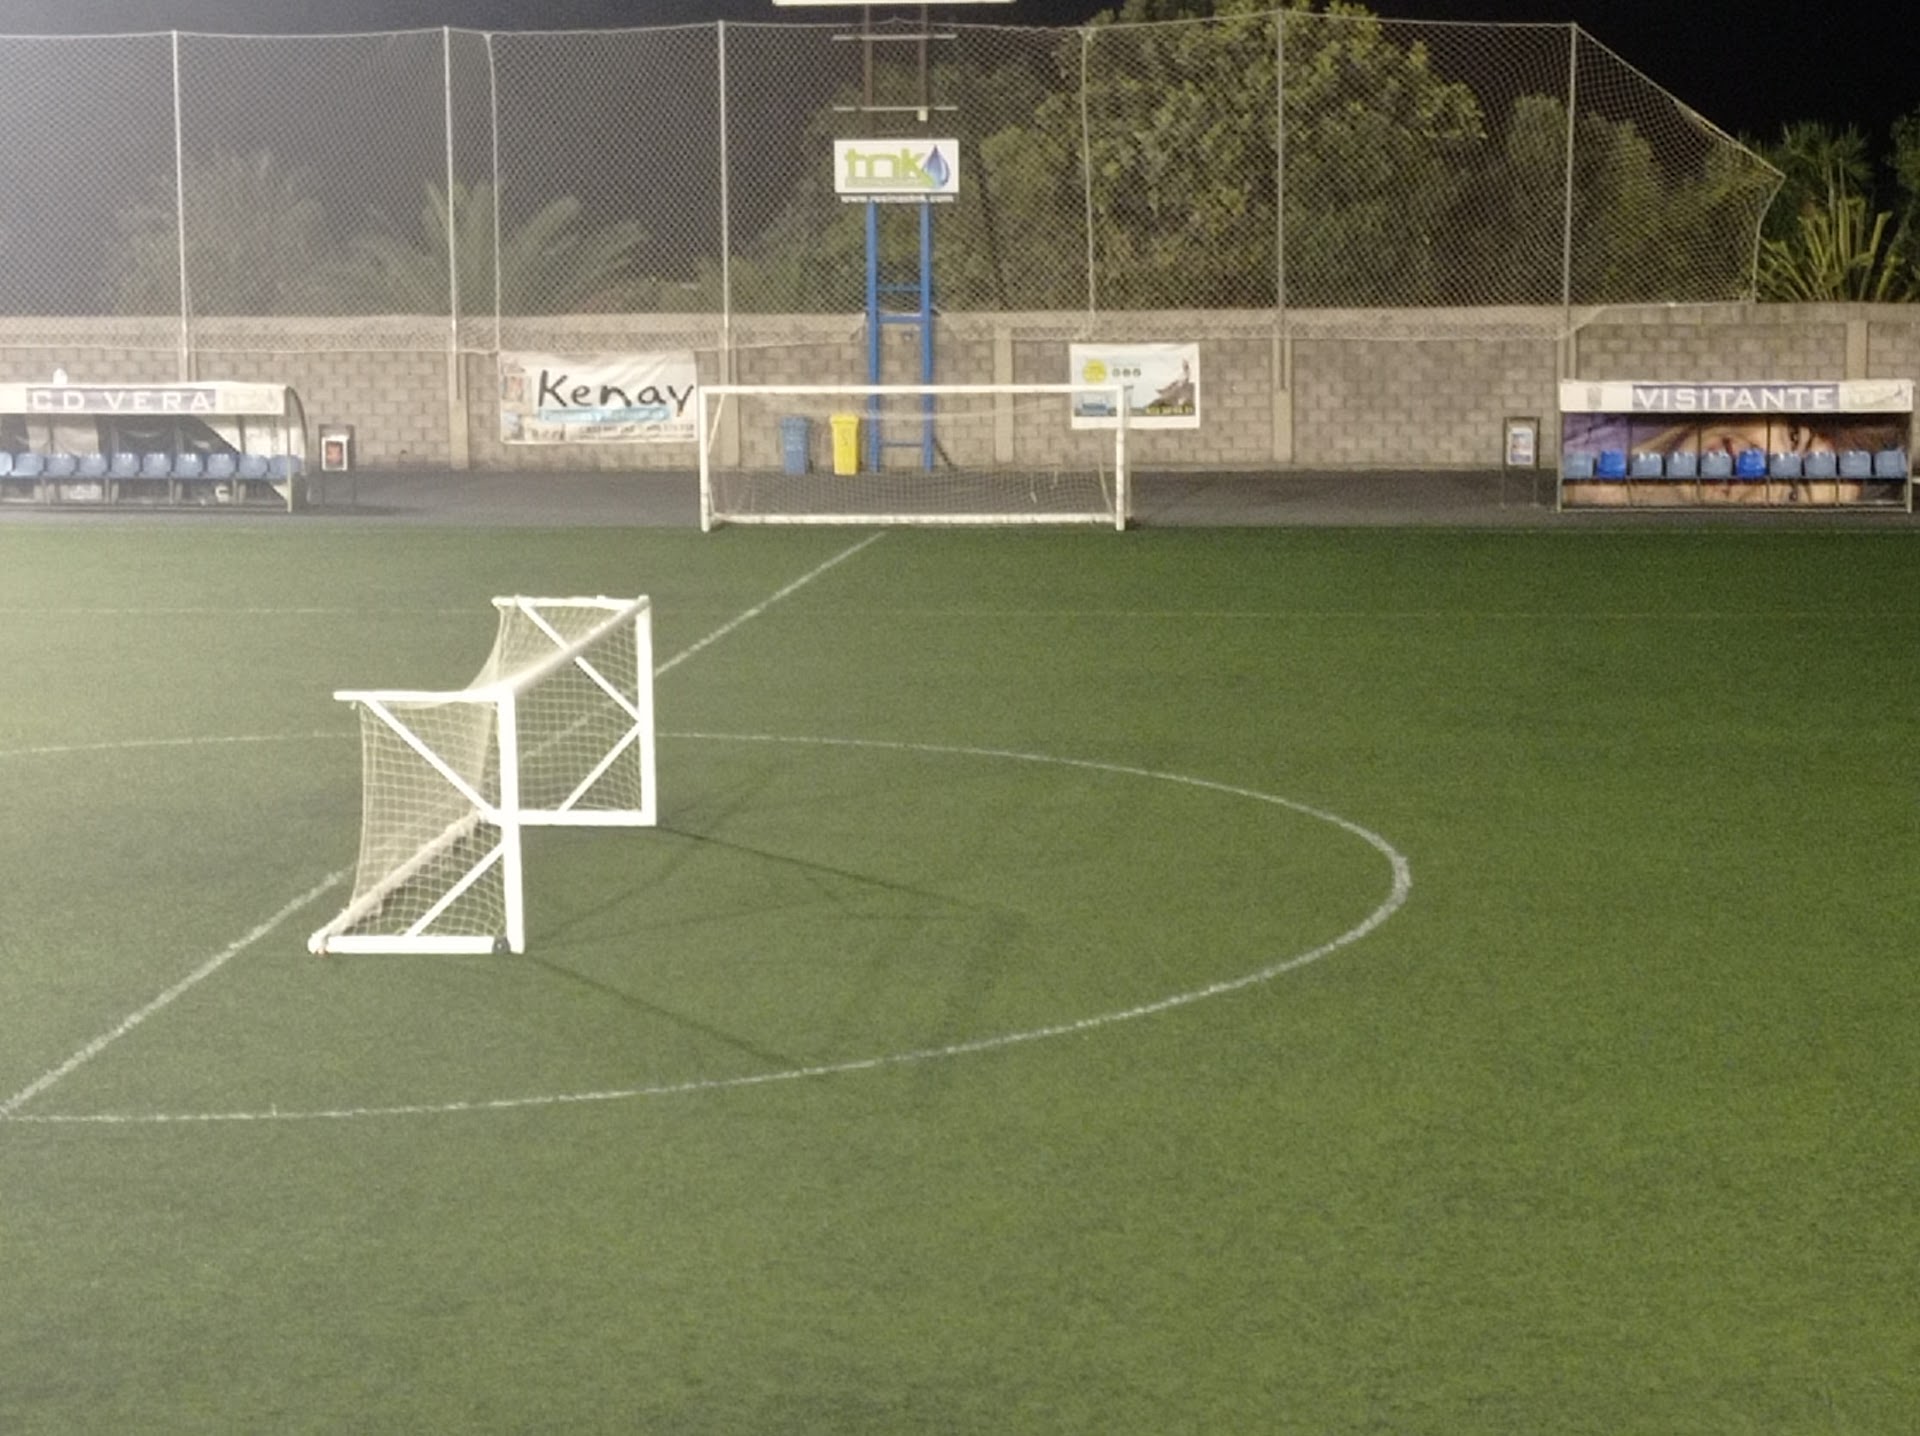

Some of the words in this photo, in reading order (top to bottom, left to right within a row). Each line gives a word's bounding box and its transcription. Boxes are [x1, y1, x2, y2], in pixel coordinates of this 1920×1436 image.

[31, 390, 85, 410] CD
[104, 391, 212, 411] VERA
[538, 369, 694, 417] Kenay
[1636, 388, 1834, 410] VISITANTE
